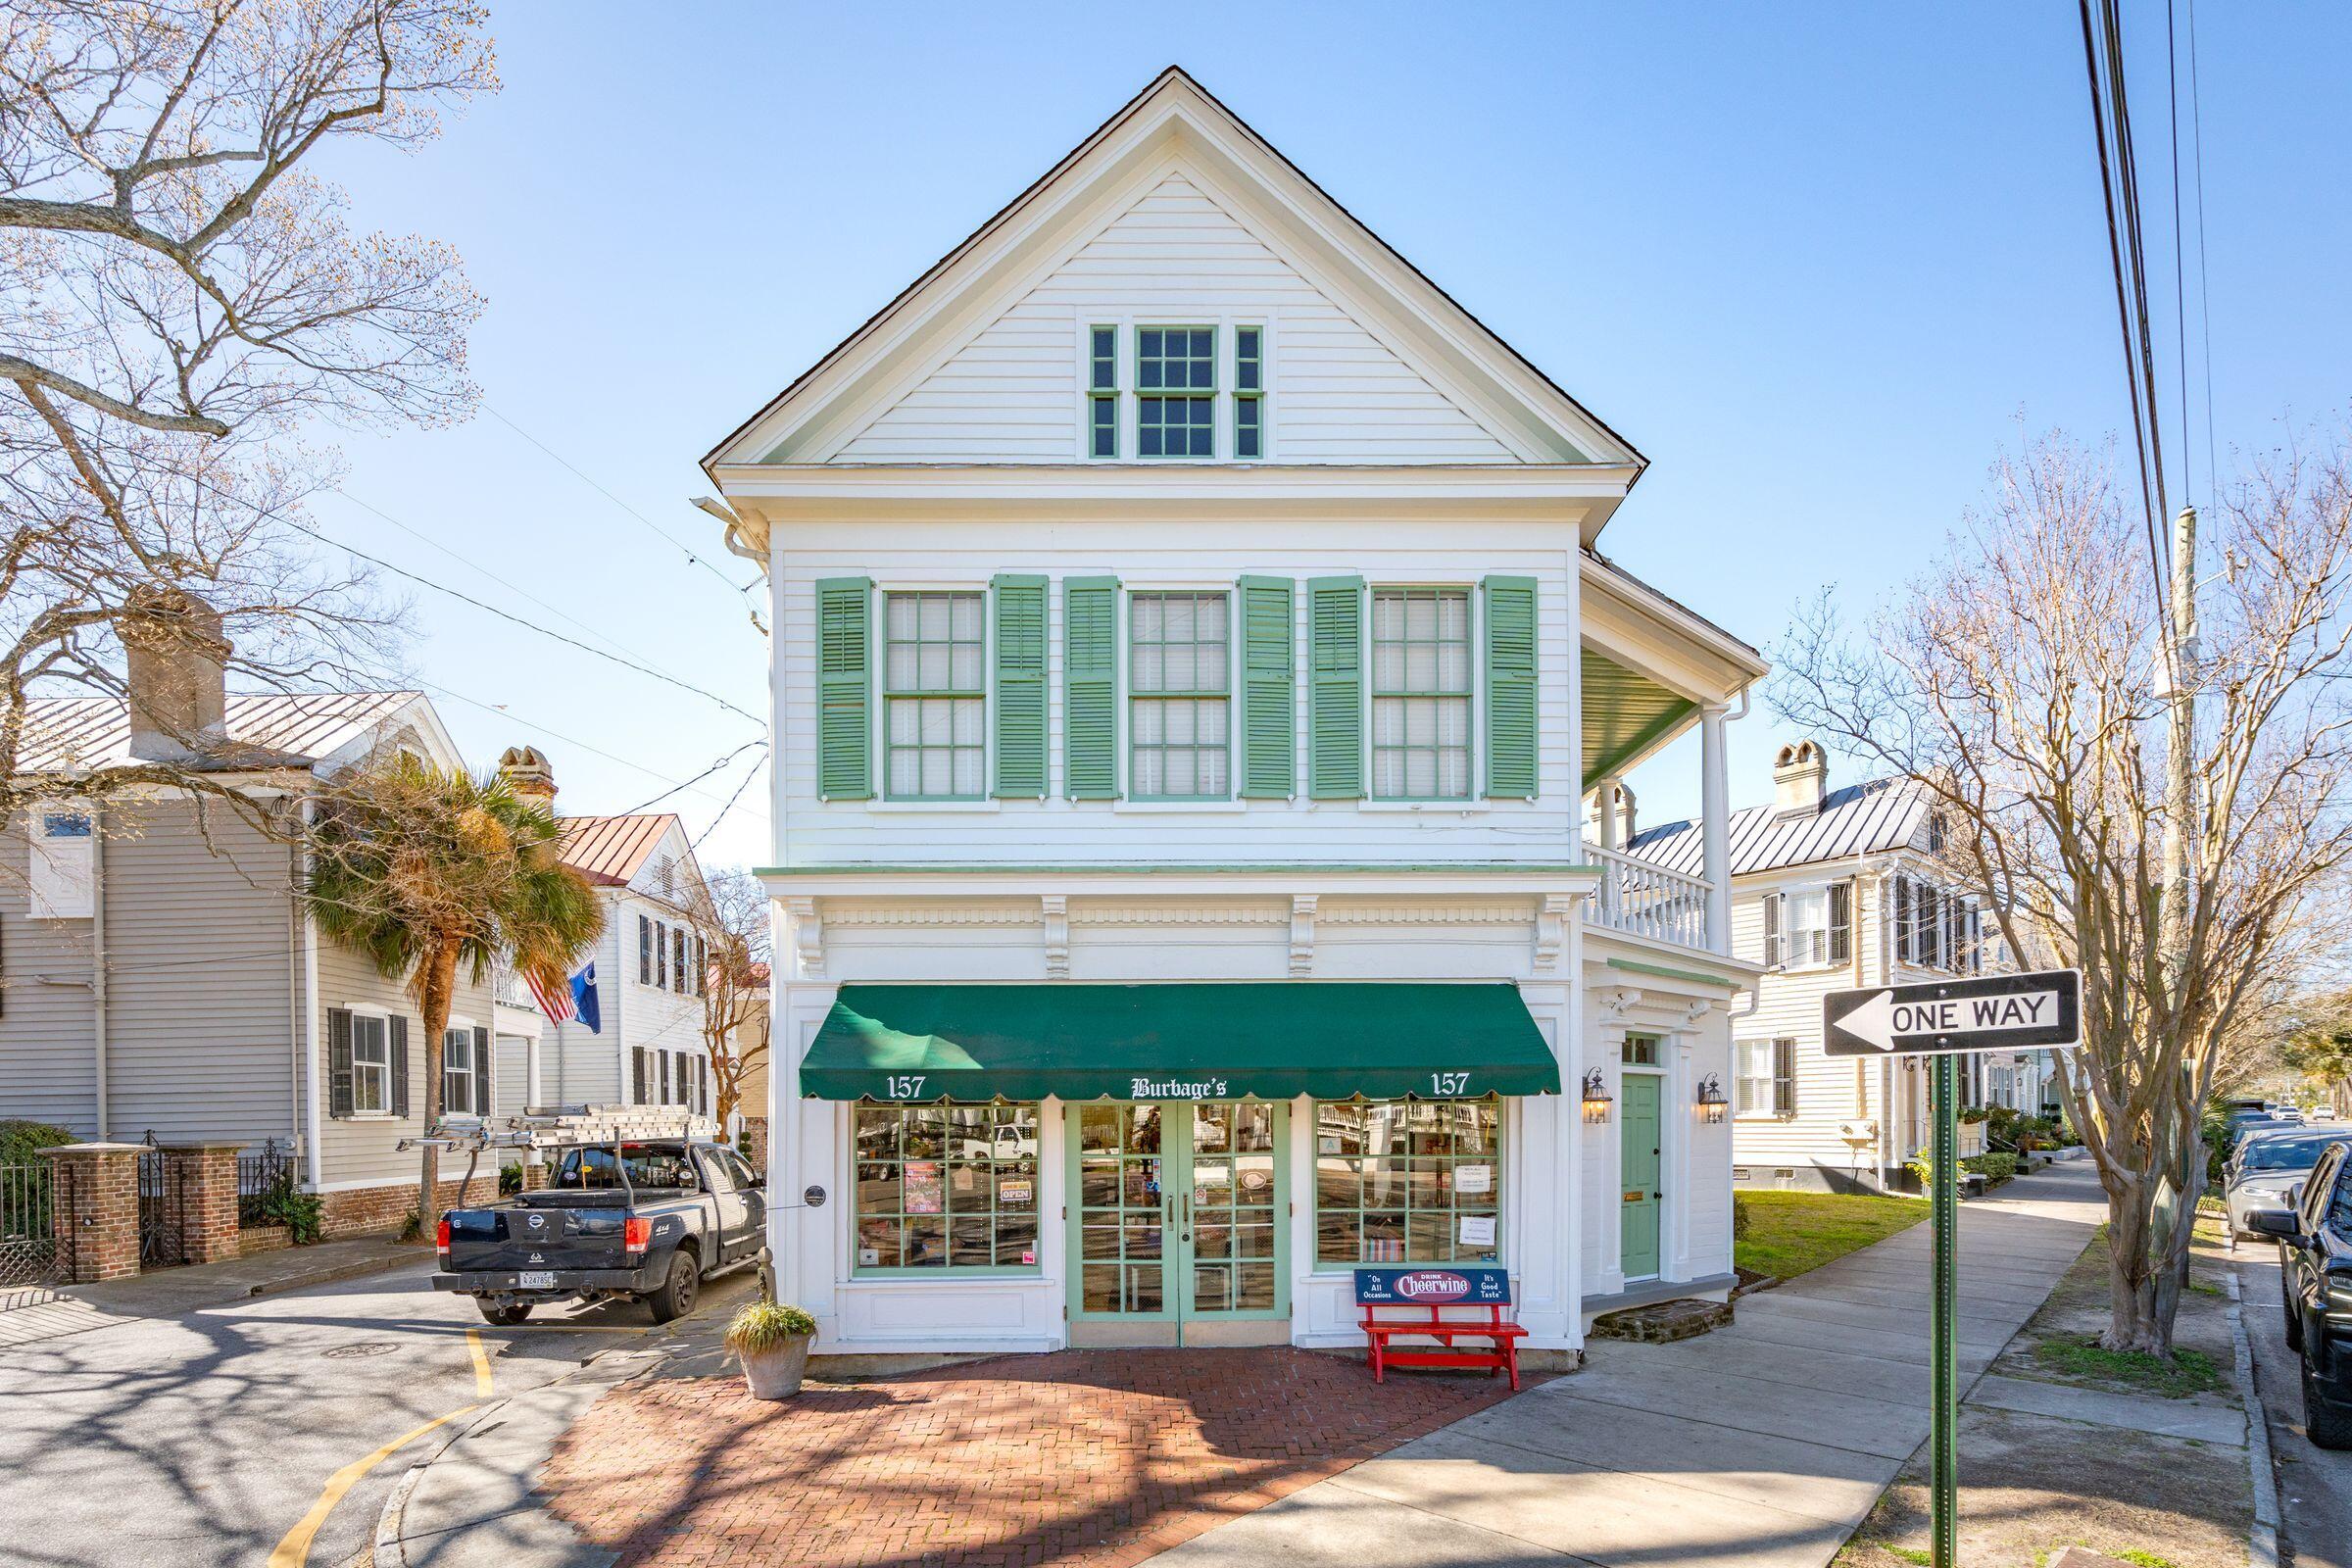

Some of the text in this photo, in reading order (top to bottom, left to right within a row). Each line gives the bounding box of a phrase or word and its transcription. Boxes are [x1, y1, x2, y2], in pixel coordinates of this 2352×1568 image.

[1892, 995, 2047, 1032] ONE WAY
[887, 1076, 926, 1099] 157
[1131, 1077, 1227, 1100] Burbage's
[1431, 1072, 1470, 1095] 157
[1003, 1190, 1029, 1199] OPEN
[1397, 1275, 1468, 1297] Cheerwine
